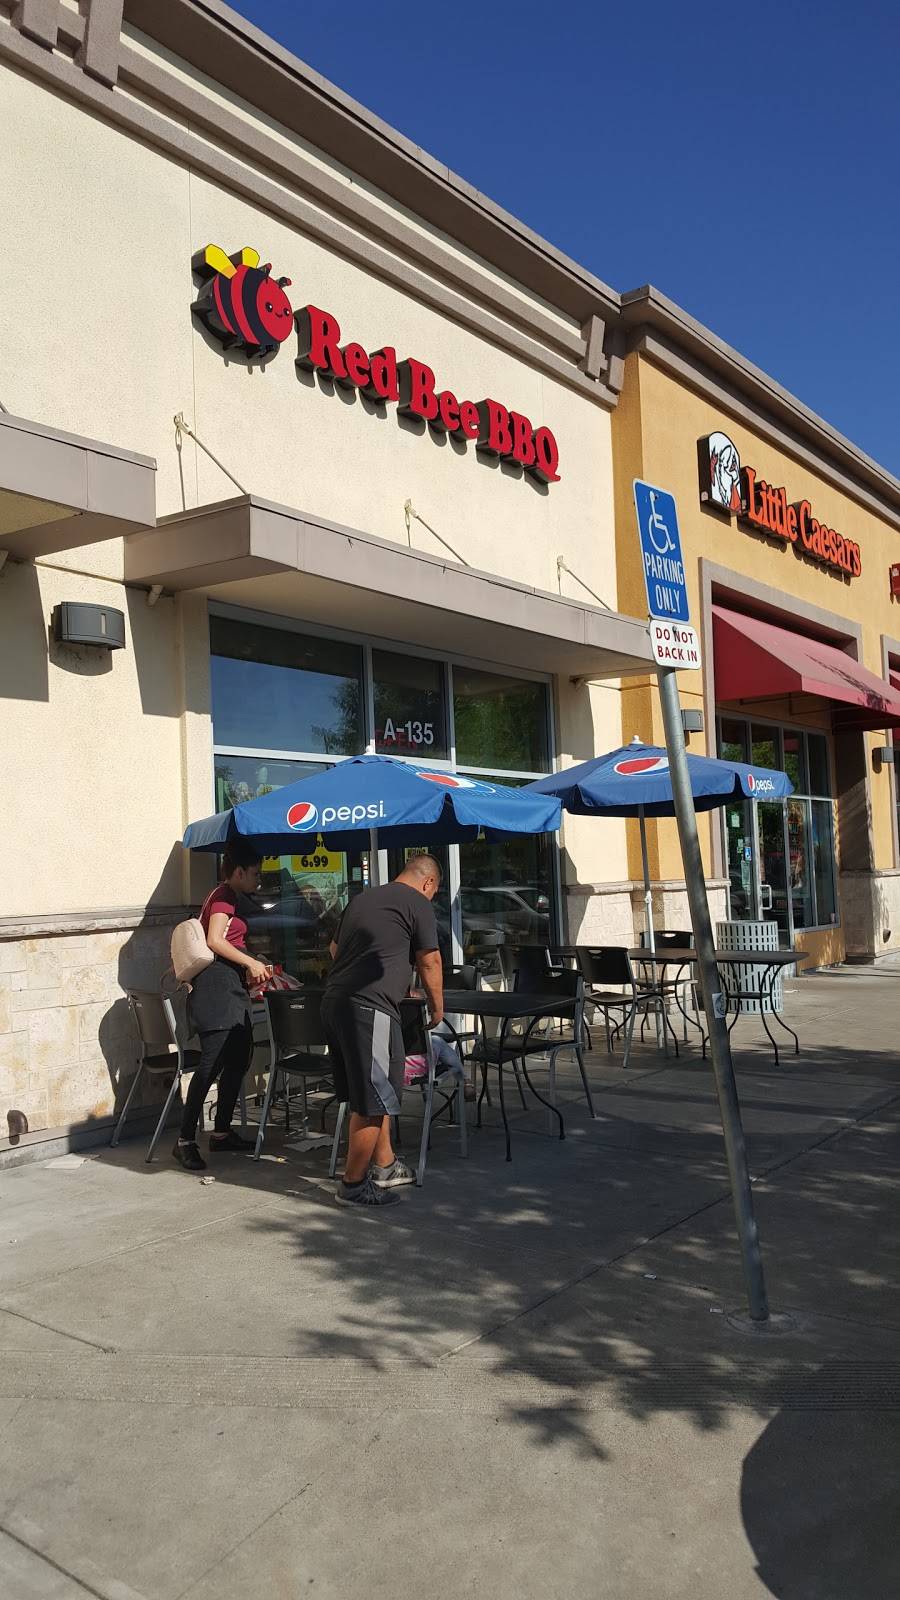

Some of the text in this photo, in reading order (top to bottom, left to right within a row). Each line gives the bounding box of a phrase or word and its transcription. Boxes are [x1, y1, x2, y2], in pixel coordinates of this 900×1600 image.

[308, 304, 561, 482] Red Bee BBQ
[746, 466, 862, 577] Little Caesars
[644, 551, 684, 586] PARKING
[655, 584, 681, 613] ONLY
[655, 627, 693, 645] DO NOT
[657, 645, 698, 662] BACK IN
[384, 718, 434, 745] A-135
[301, 855, 329, 868] 6.99
